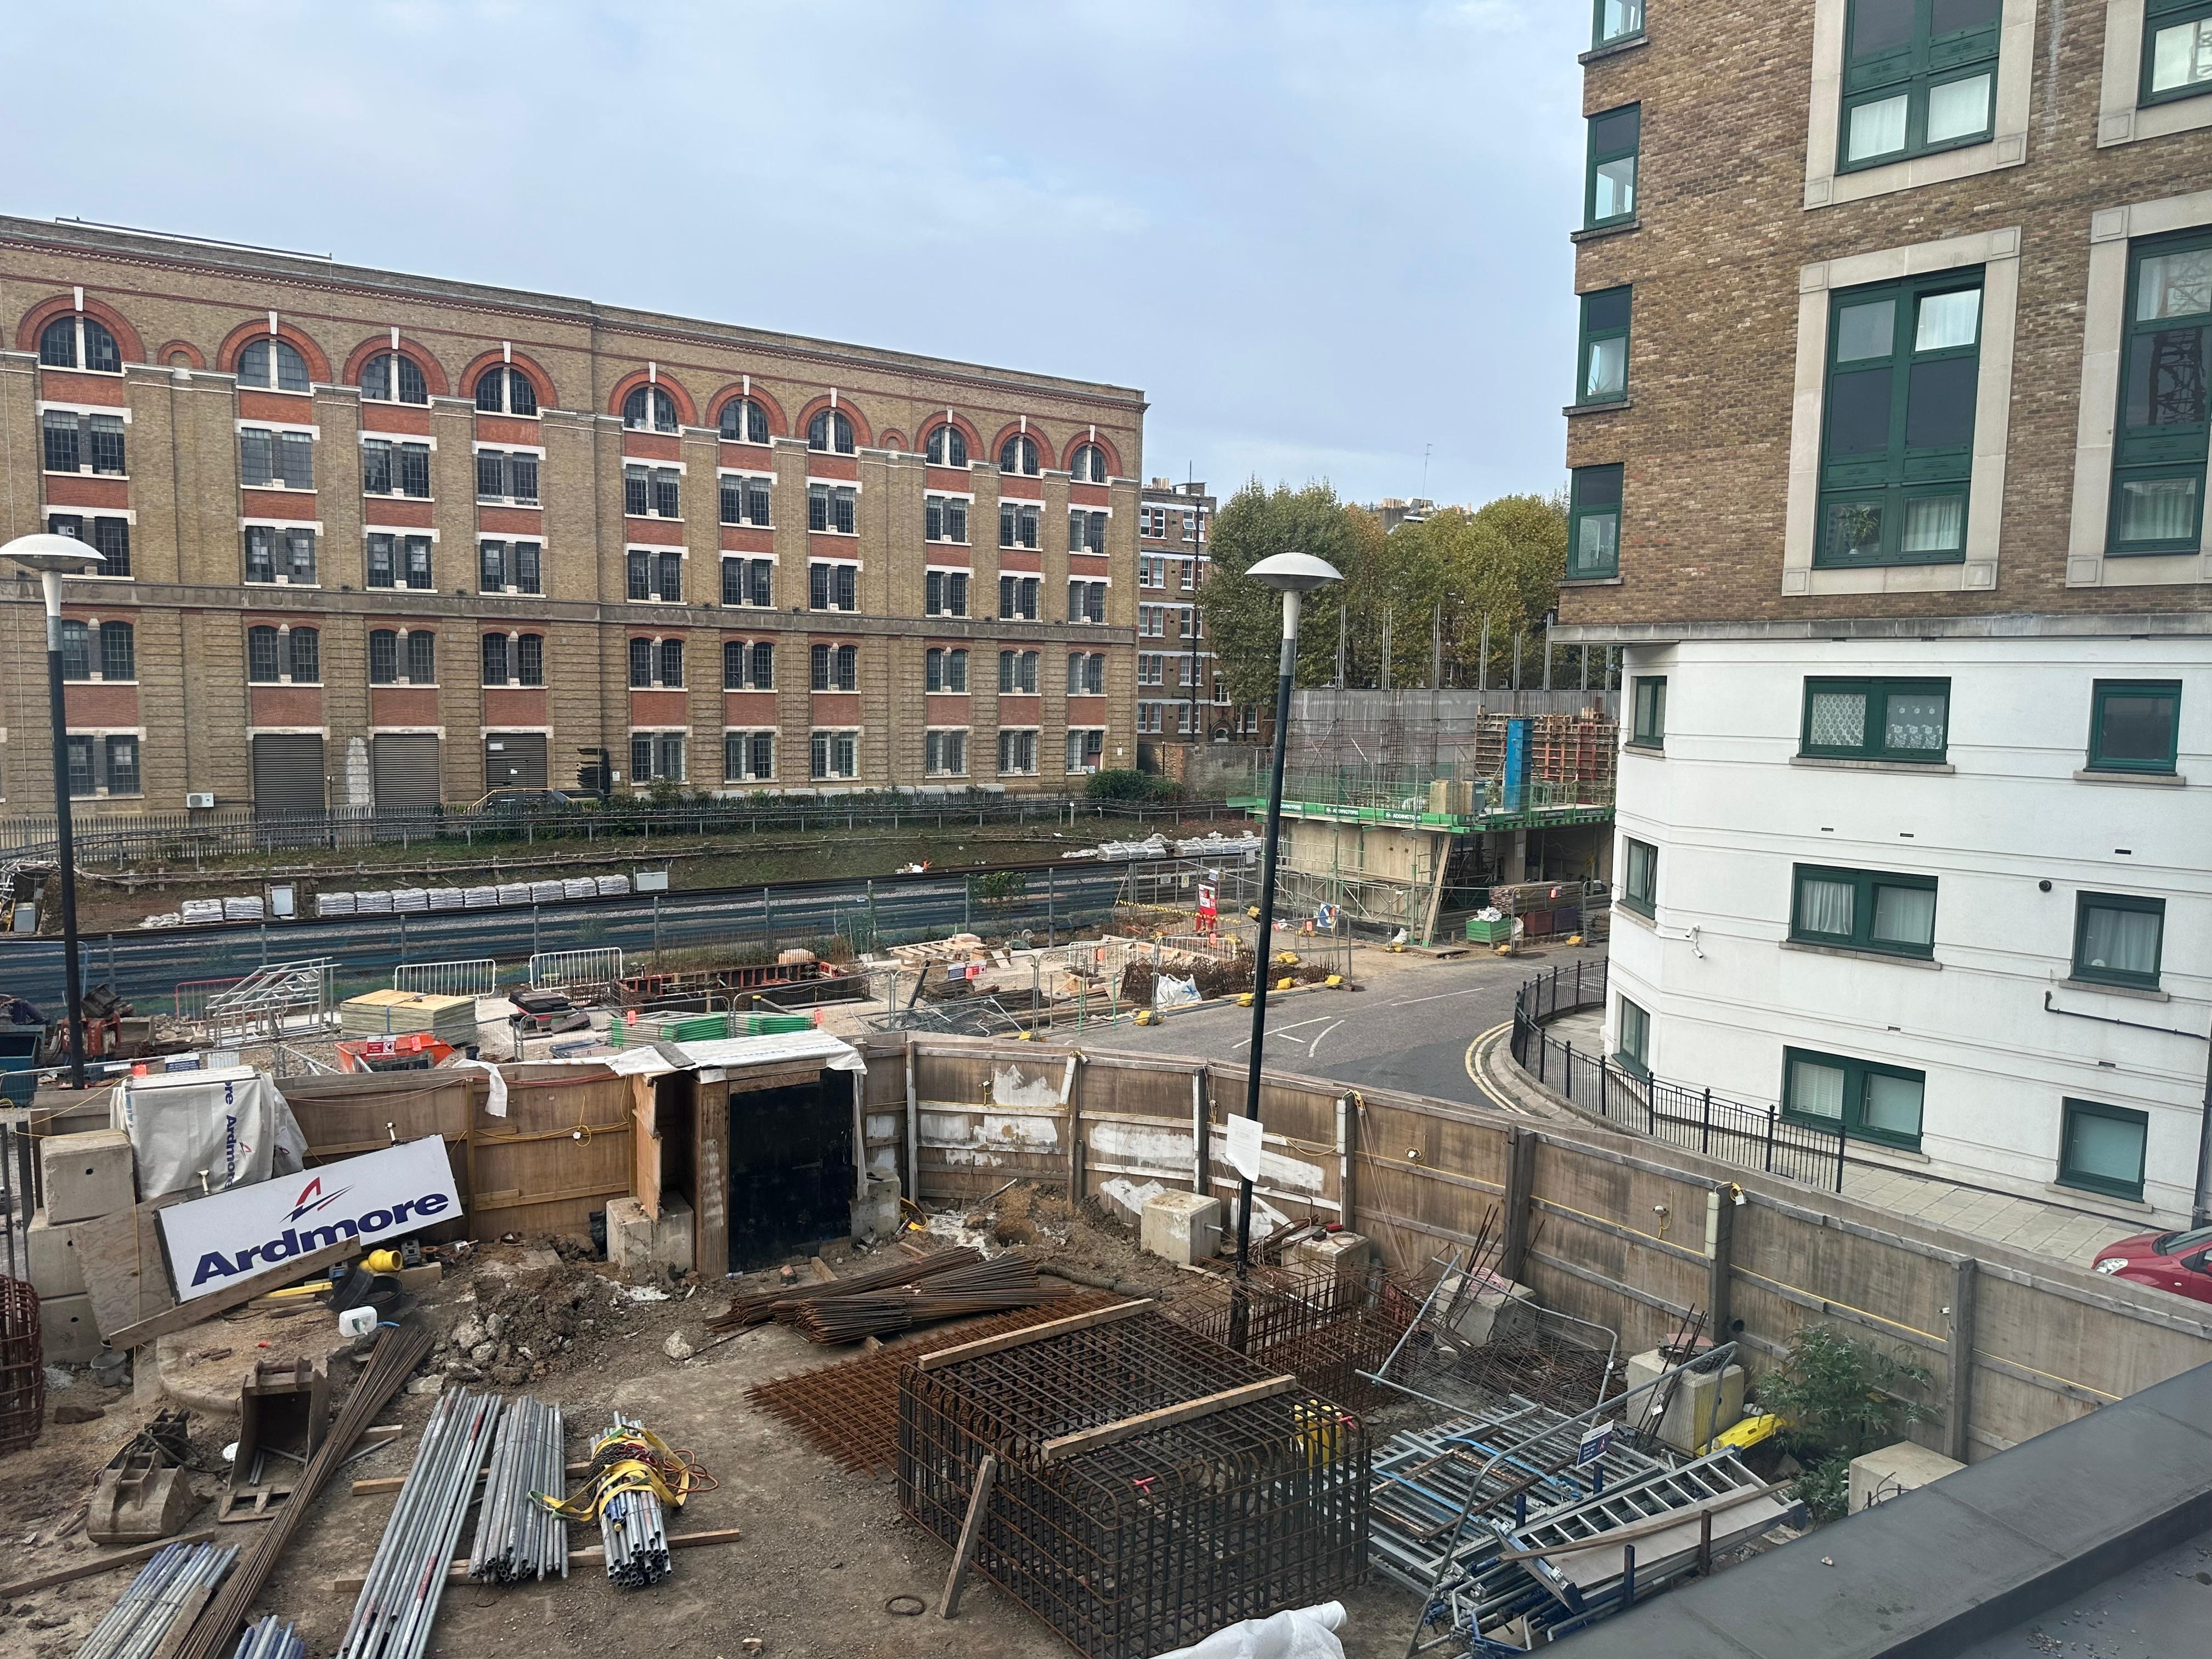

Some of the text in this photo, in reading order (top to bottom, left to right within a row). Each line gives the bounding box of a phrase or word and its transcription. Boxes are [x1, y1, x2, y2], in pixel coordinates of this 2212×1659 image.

[150, 588, 326, 607] FURNITURE
[369, 596, 551, 616] DEPOSITORIES
[605, 607, 717, 624] REMOVALS
[729, 614, 754, 626] TO
[815, 618, 862, 630] FROM
[225, 1115, 237, 1189] Ardmore
[191, 1193, 449, 1288] Ardmore
